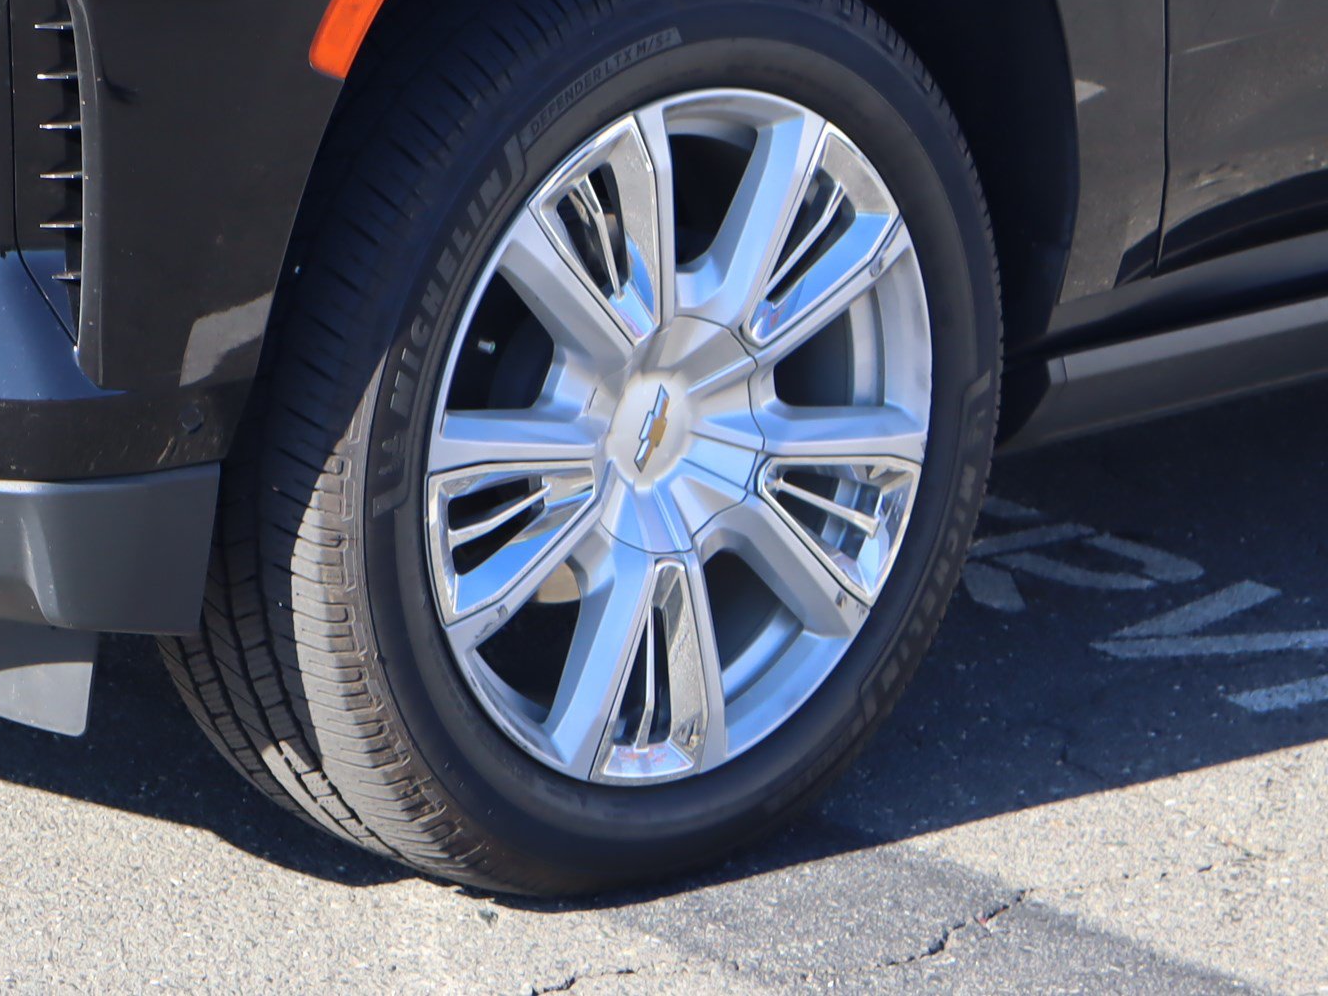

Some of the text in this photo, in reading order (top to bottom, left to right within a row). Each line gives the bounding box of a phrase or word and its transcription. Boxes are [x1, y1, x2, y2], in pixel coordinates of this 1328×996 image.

[529, 66, 602, 136] DEFENDER
[604, 53, 632, 79] LTX
[390, 167, 510, 419] MICHELIN
[881, 463, 977, 691] MICHELIN
